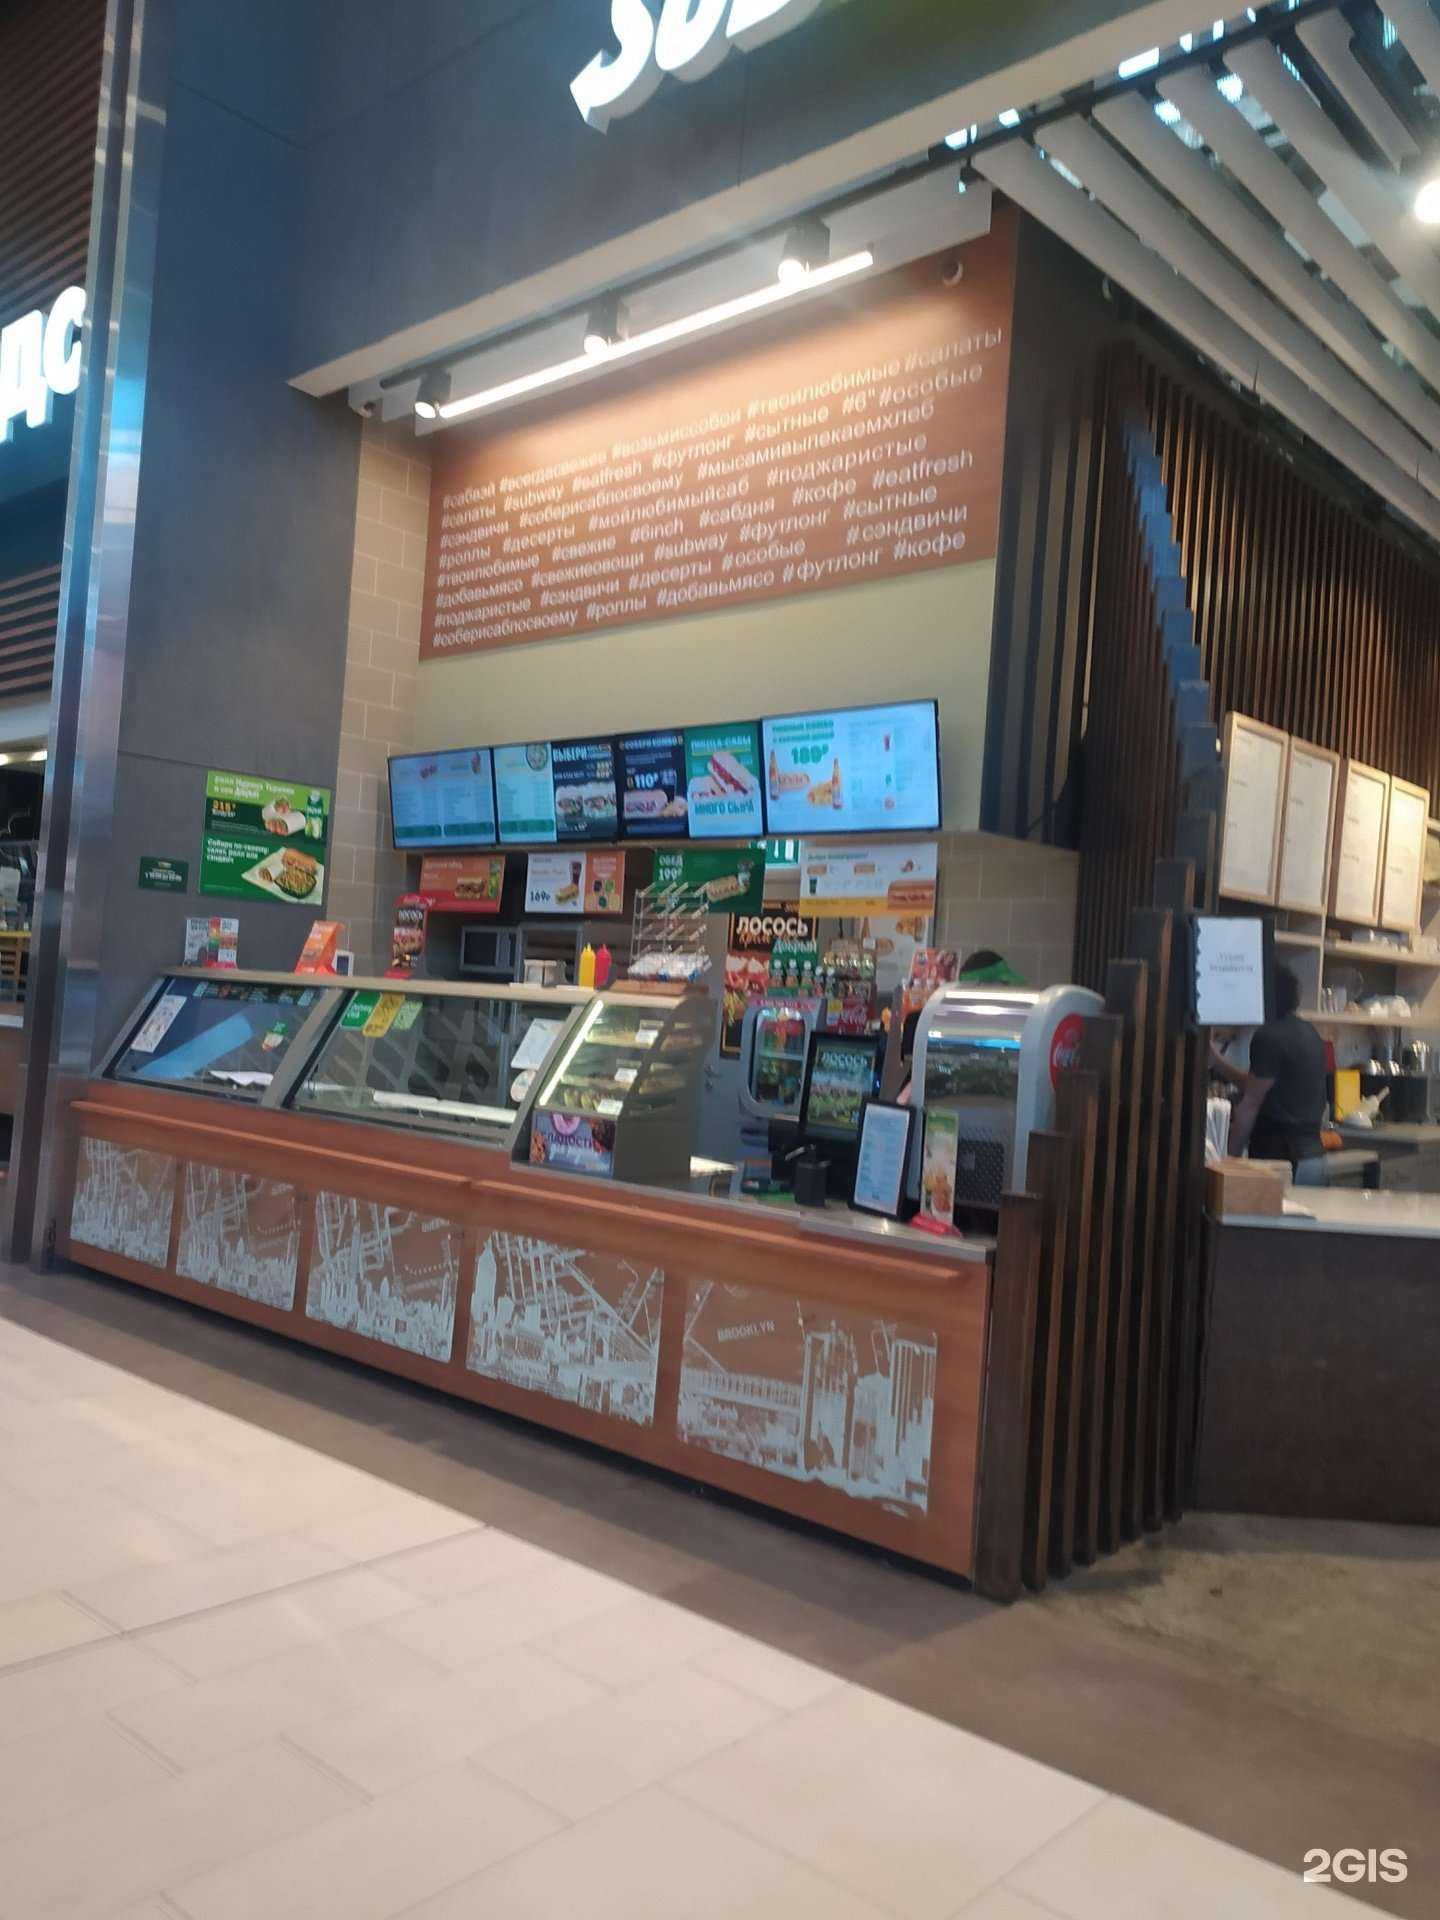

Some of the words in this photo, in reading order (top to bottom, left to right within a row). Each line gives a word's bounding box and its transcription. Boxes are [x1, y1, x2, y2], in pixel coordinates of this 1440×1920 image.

[748, 360, 900, 418] #твоилюбимые
[905, 328, 1002, 373] #салаты
[441, 504, 496, 529] #салаты
[504, 484, 564, 513] #subway
[572, 461, 645, 492] #eatfresh
[652, 434, 734, 472] #футлонг
[744, 405, 830, 443] #сытные
[879, 363, 983, 407] #особые
[503, 524, 576, 553] #десерты
[767, 433, 928, 488] #поджаристые
[531, 552, 644, 589] #свежиеовощи
[654, 532, 728, 562] #subway
[739, 508, 831, 544] #футлонг
[843, 485, 937, 521] #сытные
[552, 535, 616, 562] #свежие
[699, 497, 775, 529] #сабдня
[792, 477, 857, 507] #кофе
[872, 449, 973, 489] #eatfresh
[434, 597, 532, 628] #поджаристые
[540, 579, 620, 607] #сэндвичи
[628, 560, 712, 592] #десерты
[722, 538, 806, 572] #особые
[846, 505, 968, 546] #сэндвичи
[586, 597, 648, 622] #роллы
[656, 569, 775, 608] #добавьмясо
[782, 549, 883, 583] #футлонг
[893, 530, 966, 561] #кофе
[736, 916, 808, 936] ЛОСОСЬ
[717, 1320, 776, 1342] BROOKLYN
